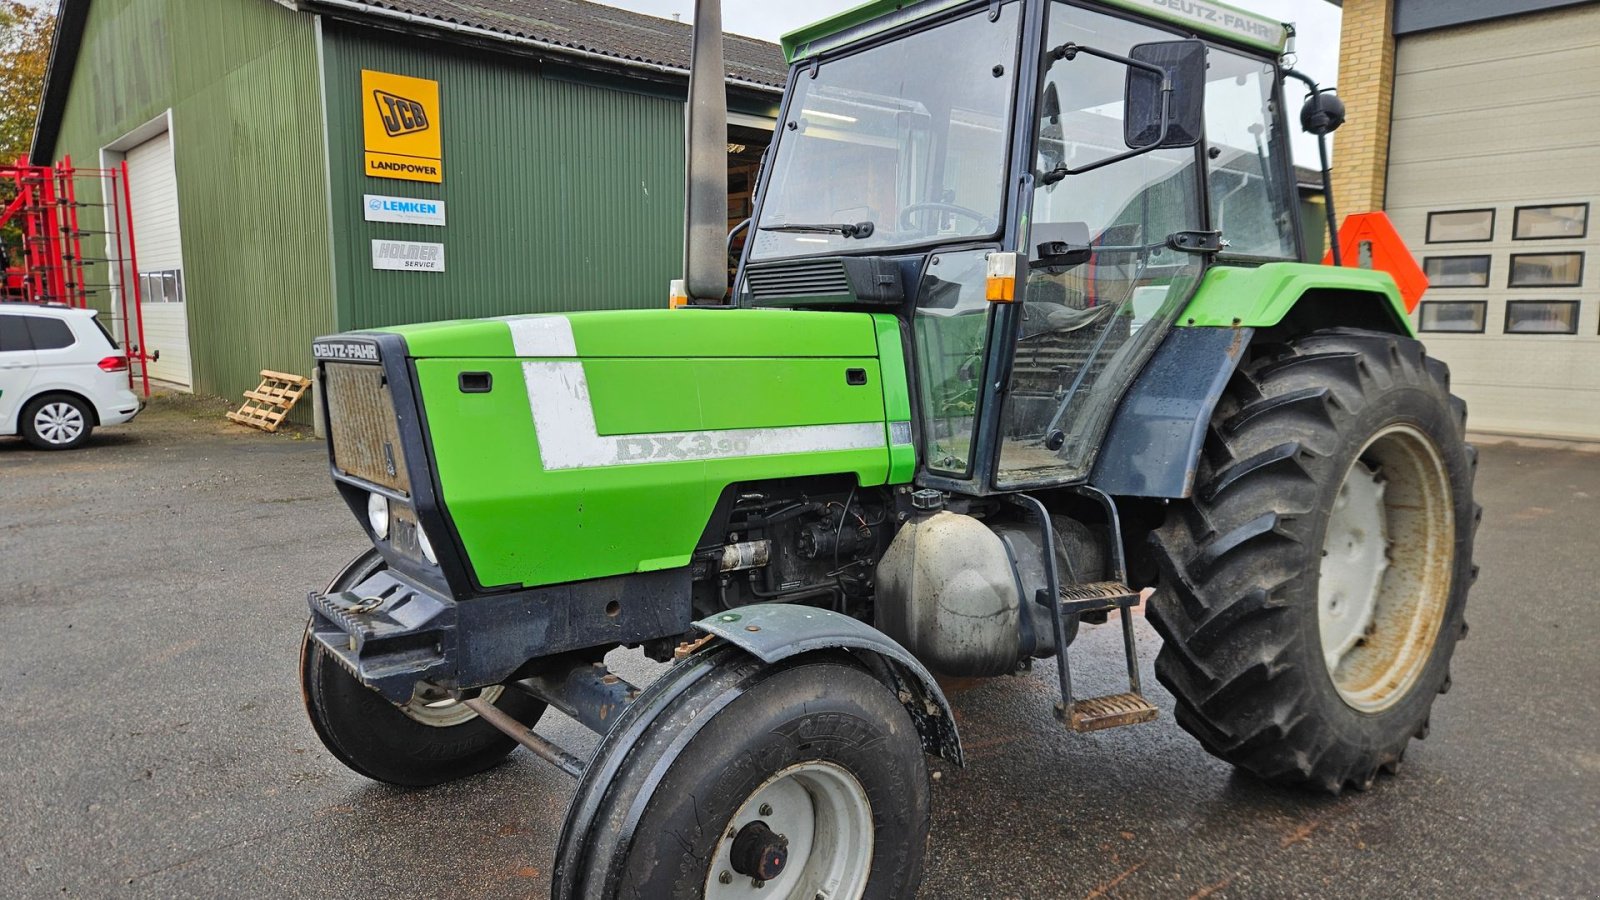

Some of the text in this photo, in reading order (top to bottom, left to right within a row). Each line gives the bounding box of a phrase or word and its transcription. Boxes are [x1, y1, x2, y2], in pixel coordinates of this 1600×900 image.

[383, 96, 426, 132] JCB
[371, 161, 437, 175] LANDPOWER
[383, 201, 436, 213] LEMKEN
[379, 243, 439, 260] HOLMER
